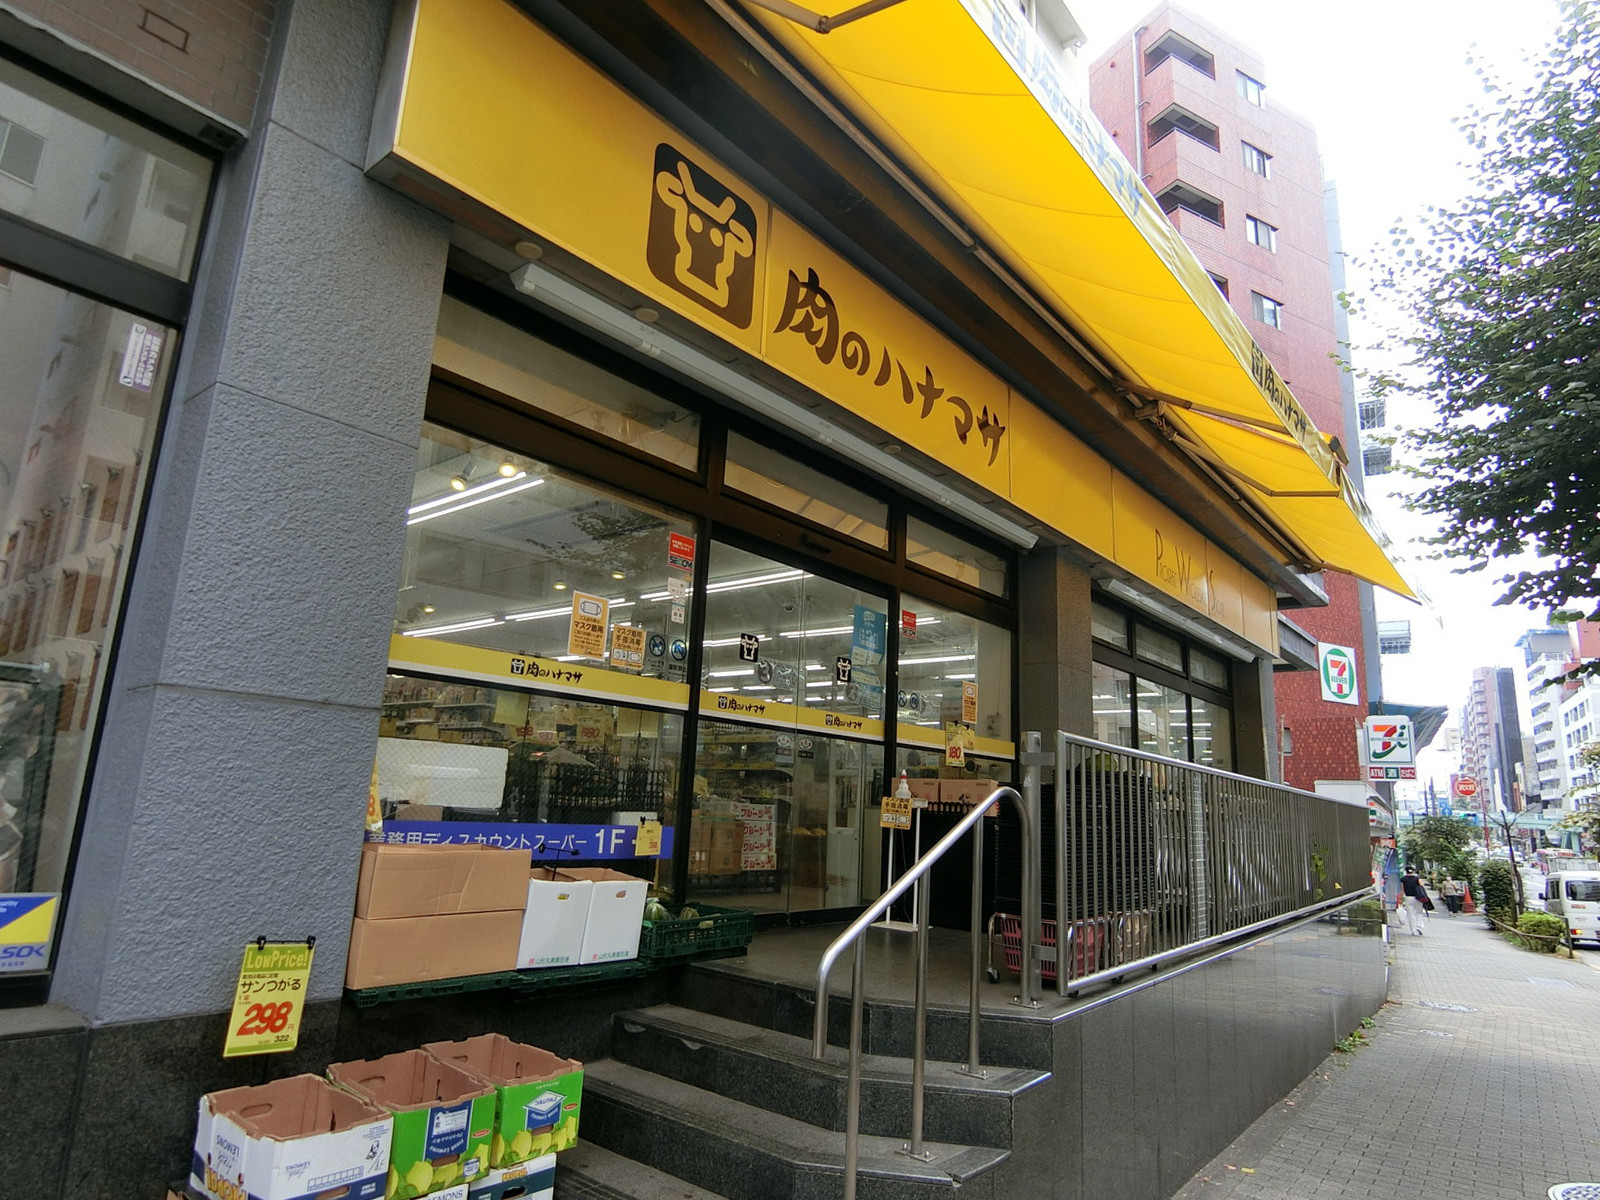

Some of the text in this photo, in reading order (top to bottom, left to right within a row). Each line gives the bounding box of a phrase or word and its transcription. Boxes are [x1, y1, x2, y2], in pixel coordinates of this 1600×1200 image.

[773, 267, 1006, 467] 肉のハナマサ
[1264, 363, 1307, 442] 肉のハナマサ
[669, 555, 693, 569] SECOM
[574, 620, 604, 634] マスク着用
[616, 627, 643, 639] マスク着用
[525, 661, 584, 684] 肉のハナマサ
[728, 698, 766, 715] 肉のハナマサ
[833, 715, 863, 731] 肉のハナマサ
[1370, 768, 1384, 778] ATM
[595, 828, 626, 854] 1F
[241, 978, 302, 994] サンつがる
[236, 1001, 294, 1036] 298
[274, 1034, 291, 1043] 322
[216, 1135, 240, 1157] LEMONS
